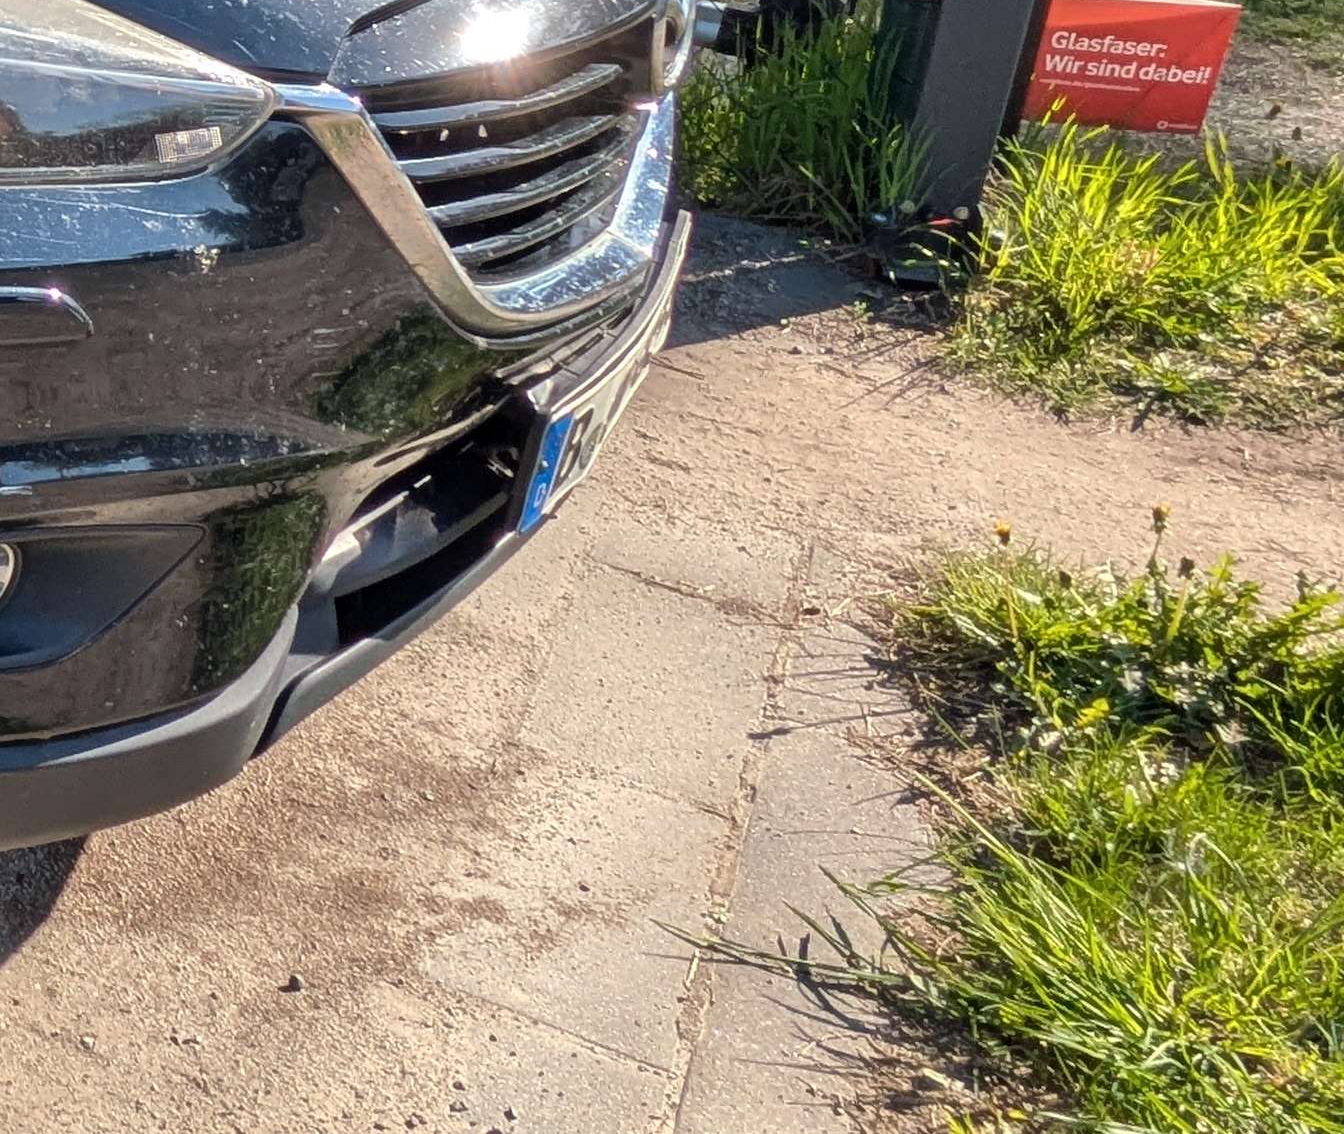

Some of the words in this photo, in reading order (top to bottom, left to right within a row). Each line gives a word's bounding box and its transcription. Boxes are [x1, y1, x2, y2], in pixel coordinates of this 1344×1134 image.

[1051, 31, 1167, 57] Glasfaser:
[1045, 54, 1085, 74] Wir
[1087, 60, 1138, 80] sind
[1139, 64, 1211, 85] dabei!
